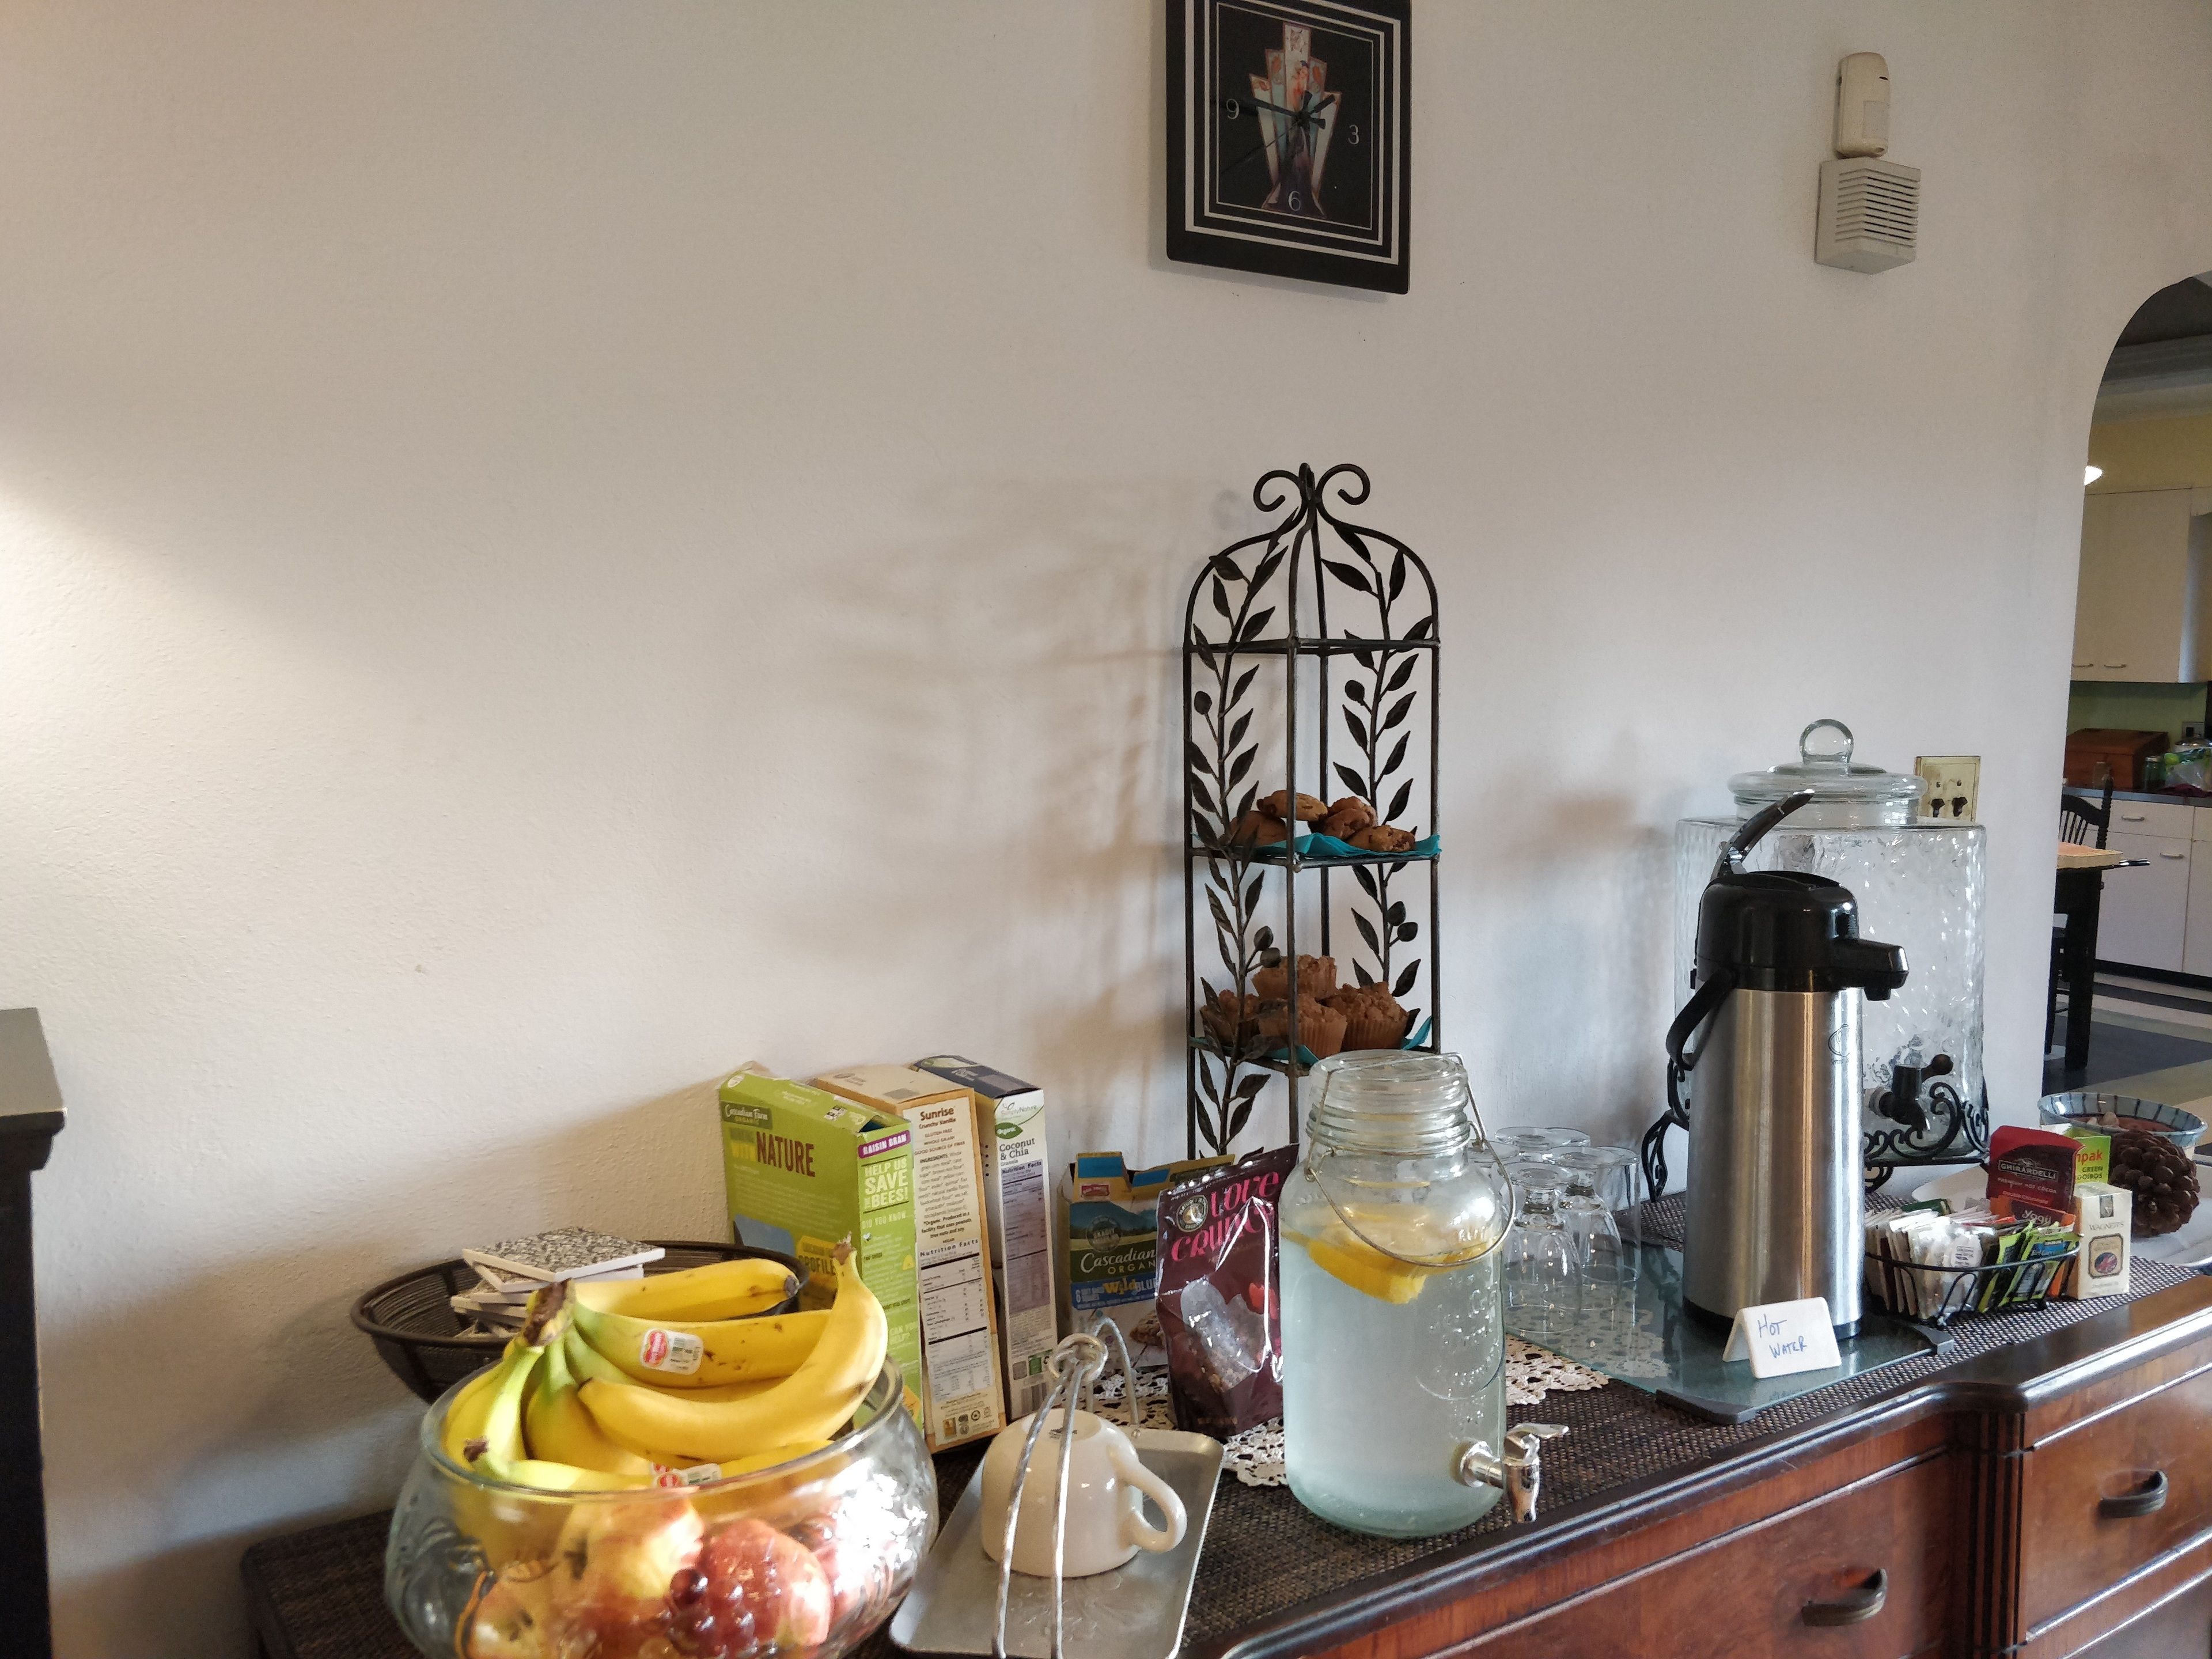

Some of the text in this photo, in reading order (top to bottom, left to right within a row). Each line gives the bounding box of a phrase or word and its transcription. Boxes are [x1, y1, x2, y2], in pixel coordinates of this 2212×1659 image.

[1226, 98, 1240, 120] 9
[1348, 124, 1360, 145] 3
[1288, 191, 1301, 211] 6
[920, 1107, 954, 1121] Sunrise
[756, 1131, 816, 1177] NATURE
[863, 1133, 907, 1156] RAISIN BRAN
[999, 1138, 1035, 1152] Coconut
[1001, 1147, 1029, 1161] & Chia
[865, 1158, 907, 1177] HELP US
[2001, 1163, 2056, 1179] GHIRARDELLI
[865, 1169, 908, 1195] SAVE
[872, 1187, 908, 1208] BEES!
[920, 1239, 978, 1256] Nutrition Facts
[1081, 1248, 1156, 1273] Cascadian
[1108, 1260, 1156, 1274] ORGAN
[1758, 1313, 1787, 1338] HOT
[1769, 1335, 1808, 1358] WATER
